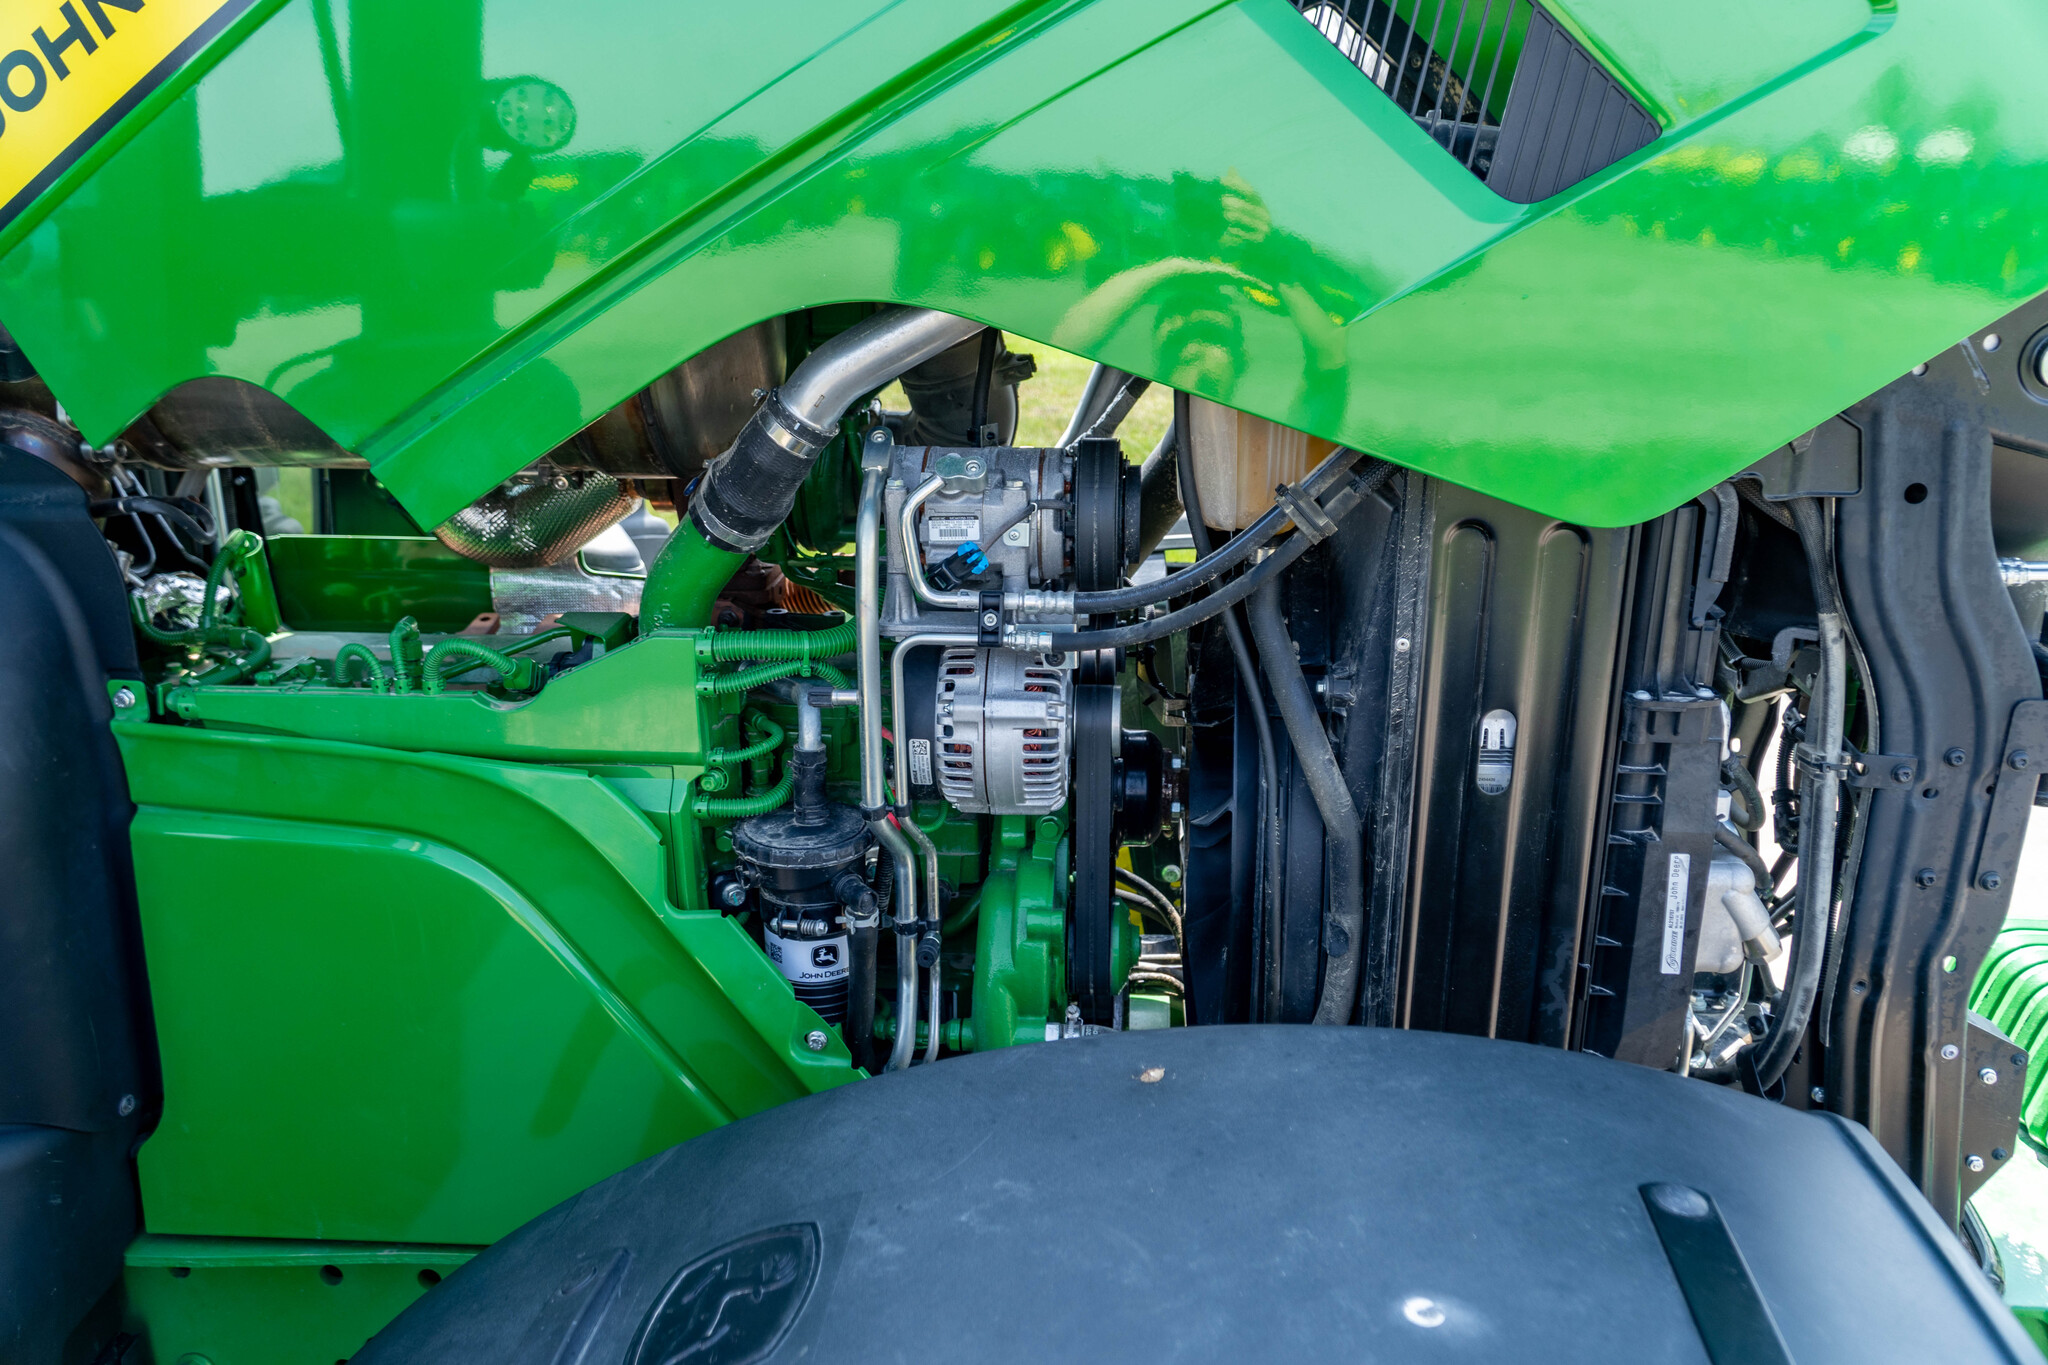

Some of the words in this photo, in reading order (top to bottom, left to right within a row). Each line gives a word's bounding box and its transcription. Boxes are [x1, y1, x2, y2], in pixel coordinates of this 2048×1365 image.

[0, 0, 146, 138] OHN
[1671, 855, 1680, 878] Deere
[1670, 881, 1679, 900] John
[800, 971, 823, 979] JOHN
